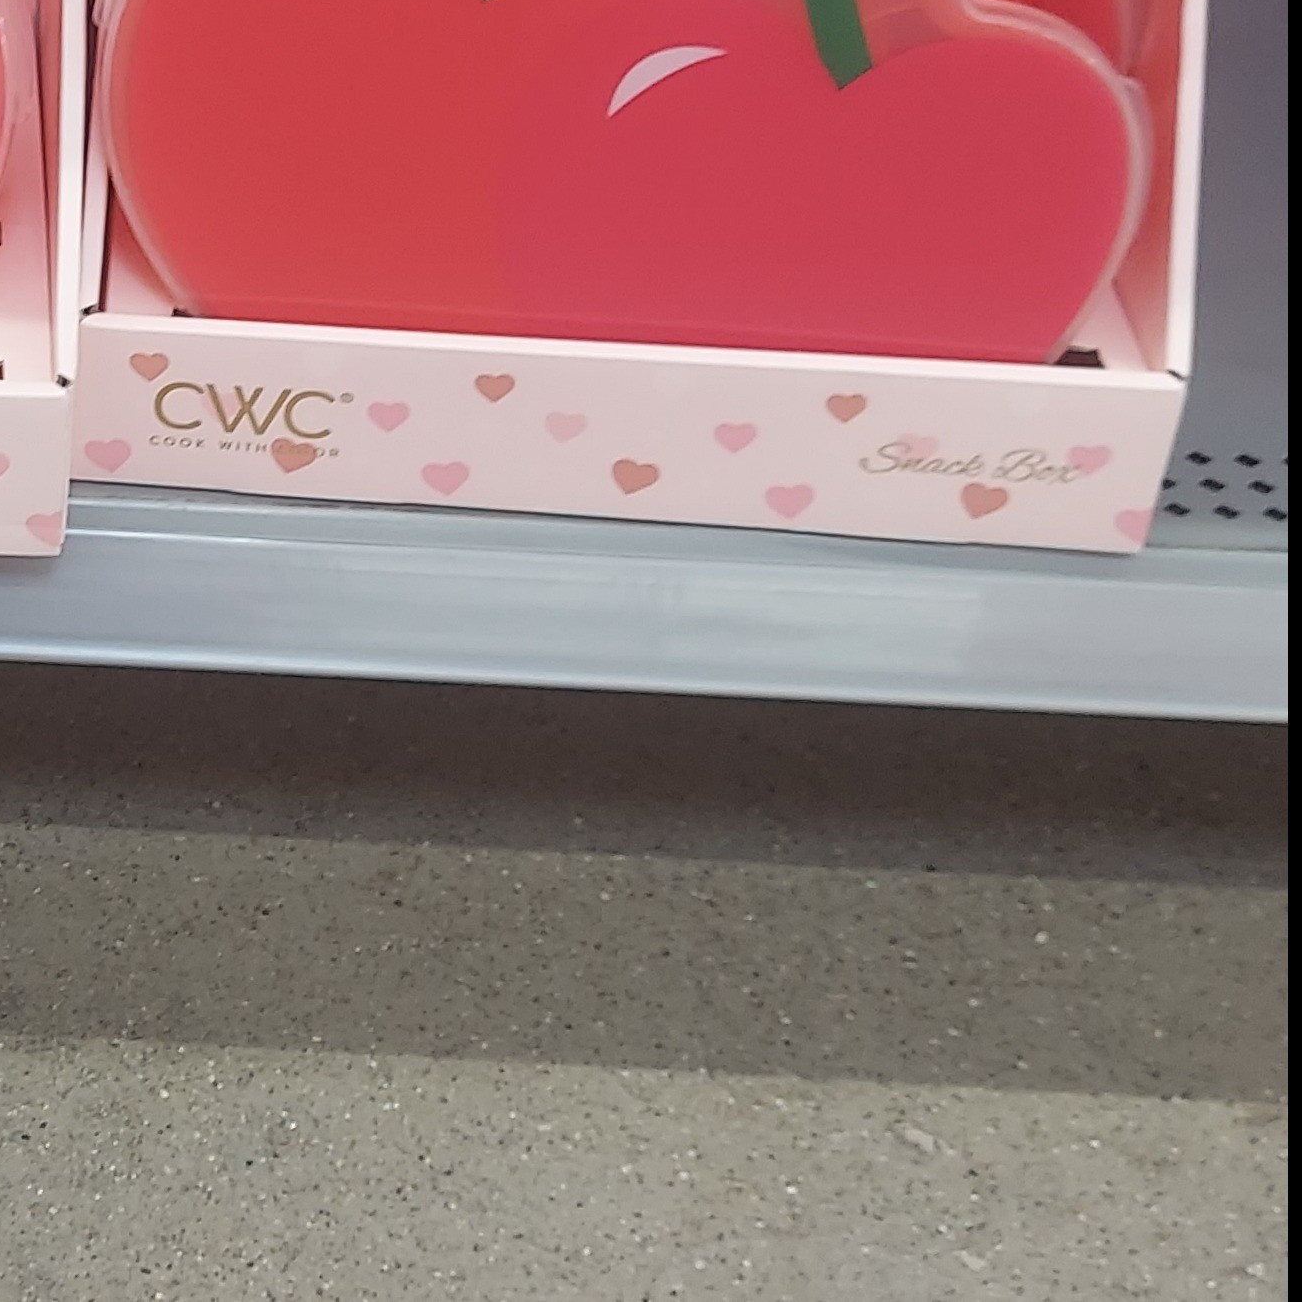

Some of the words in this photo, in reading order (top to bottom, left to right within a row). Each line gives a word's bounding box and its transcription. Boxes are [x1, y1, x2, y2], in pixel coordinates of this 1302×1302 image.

[149, 435, 205, 448] COOK
[219, 440, 268, 453] WITH
[859, 441, 984, 476] Snack
[991, 449, 1081, 485] Box
